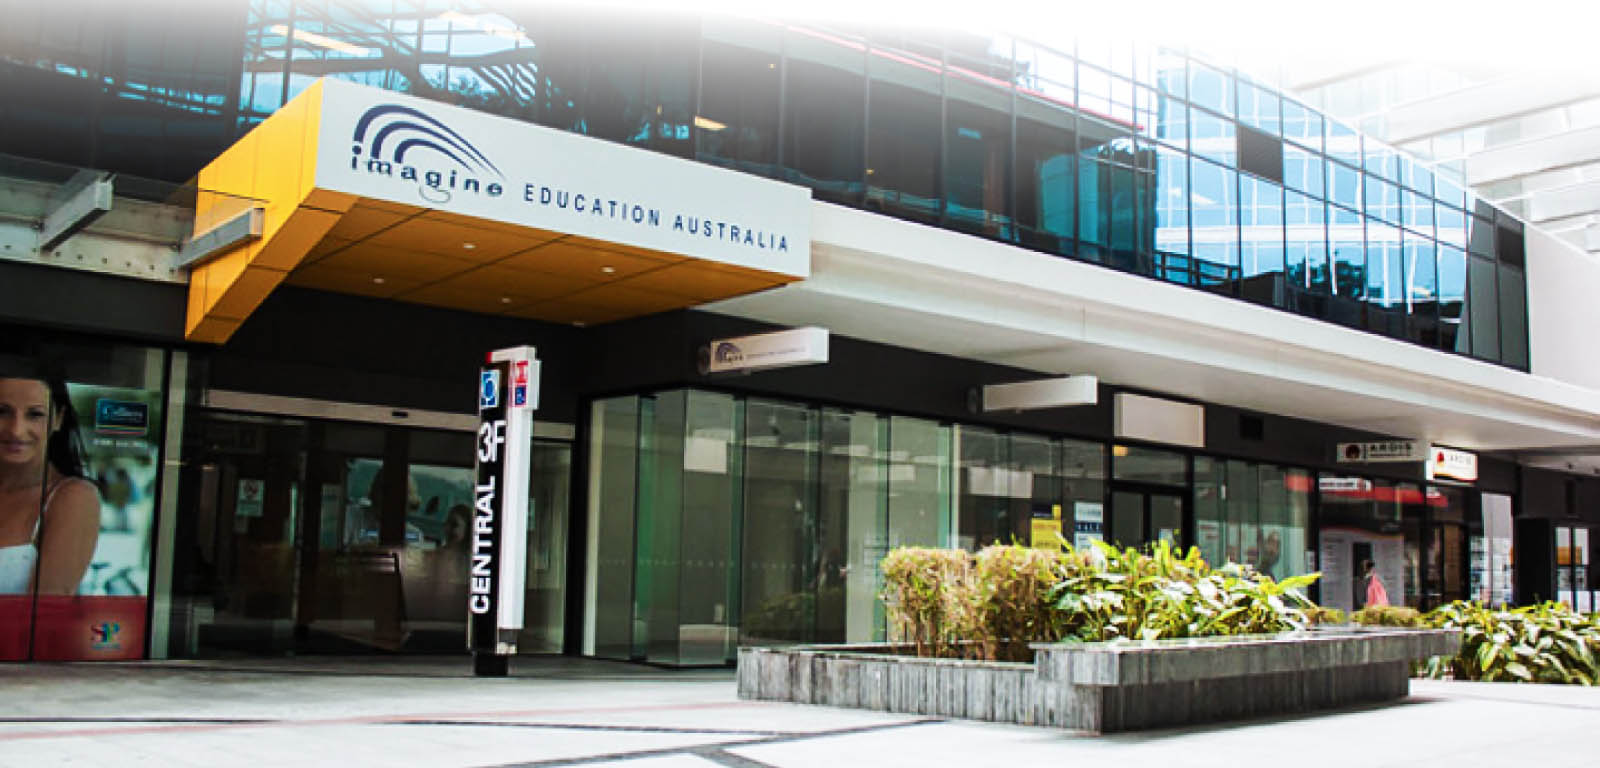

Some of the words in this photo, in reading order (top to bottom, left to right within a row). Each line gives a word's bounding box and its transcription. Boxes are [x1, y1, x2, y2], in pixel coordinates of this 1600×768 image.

[351, 144, 504, 203] imagine
[523, 183, 660, 227] EDUCATION
[672, 214, 789, 253] AUSTRALIA
[469, 475, 496, 615] CENTRAL
